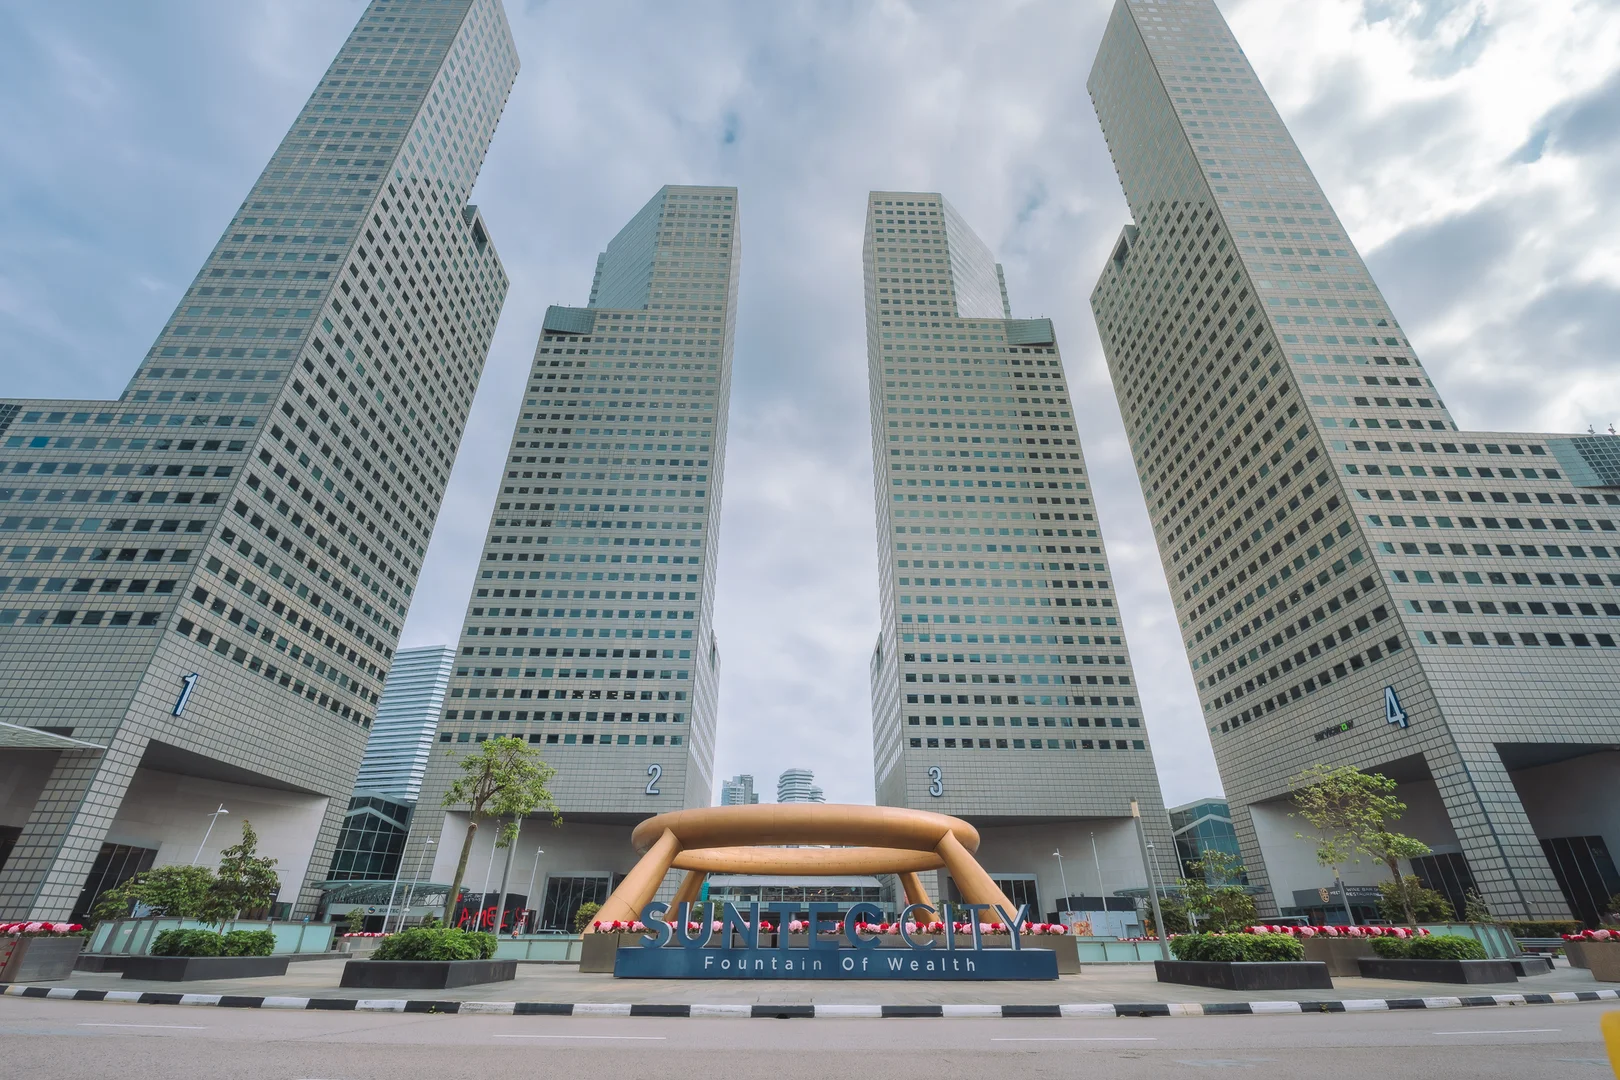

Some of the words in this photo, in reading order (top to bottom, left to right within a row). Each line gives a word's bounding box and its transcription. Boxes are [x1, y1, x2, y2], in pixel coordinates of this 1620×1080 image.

[172, 672, 199, 717] 1
[1384, 685, 1409, 729] 4
[645, 763, 663, 796] 2
[928, 765, 944, 798] 3
[638, 901, 882, 951] SUNTEC
[900, 903, 1031, 951] CITY
[704, 956, 822, 971] Fountain
[842, 957, 868, 971] Of
[887, 957, 976, 972] Wealth
